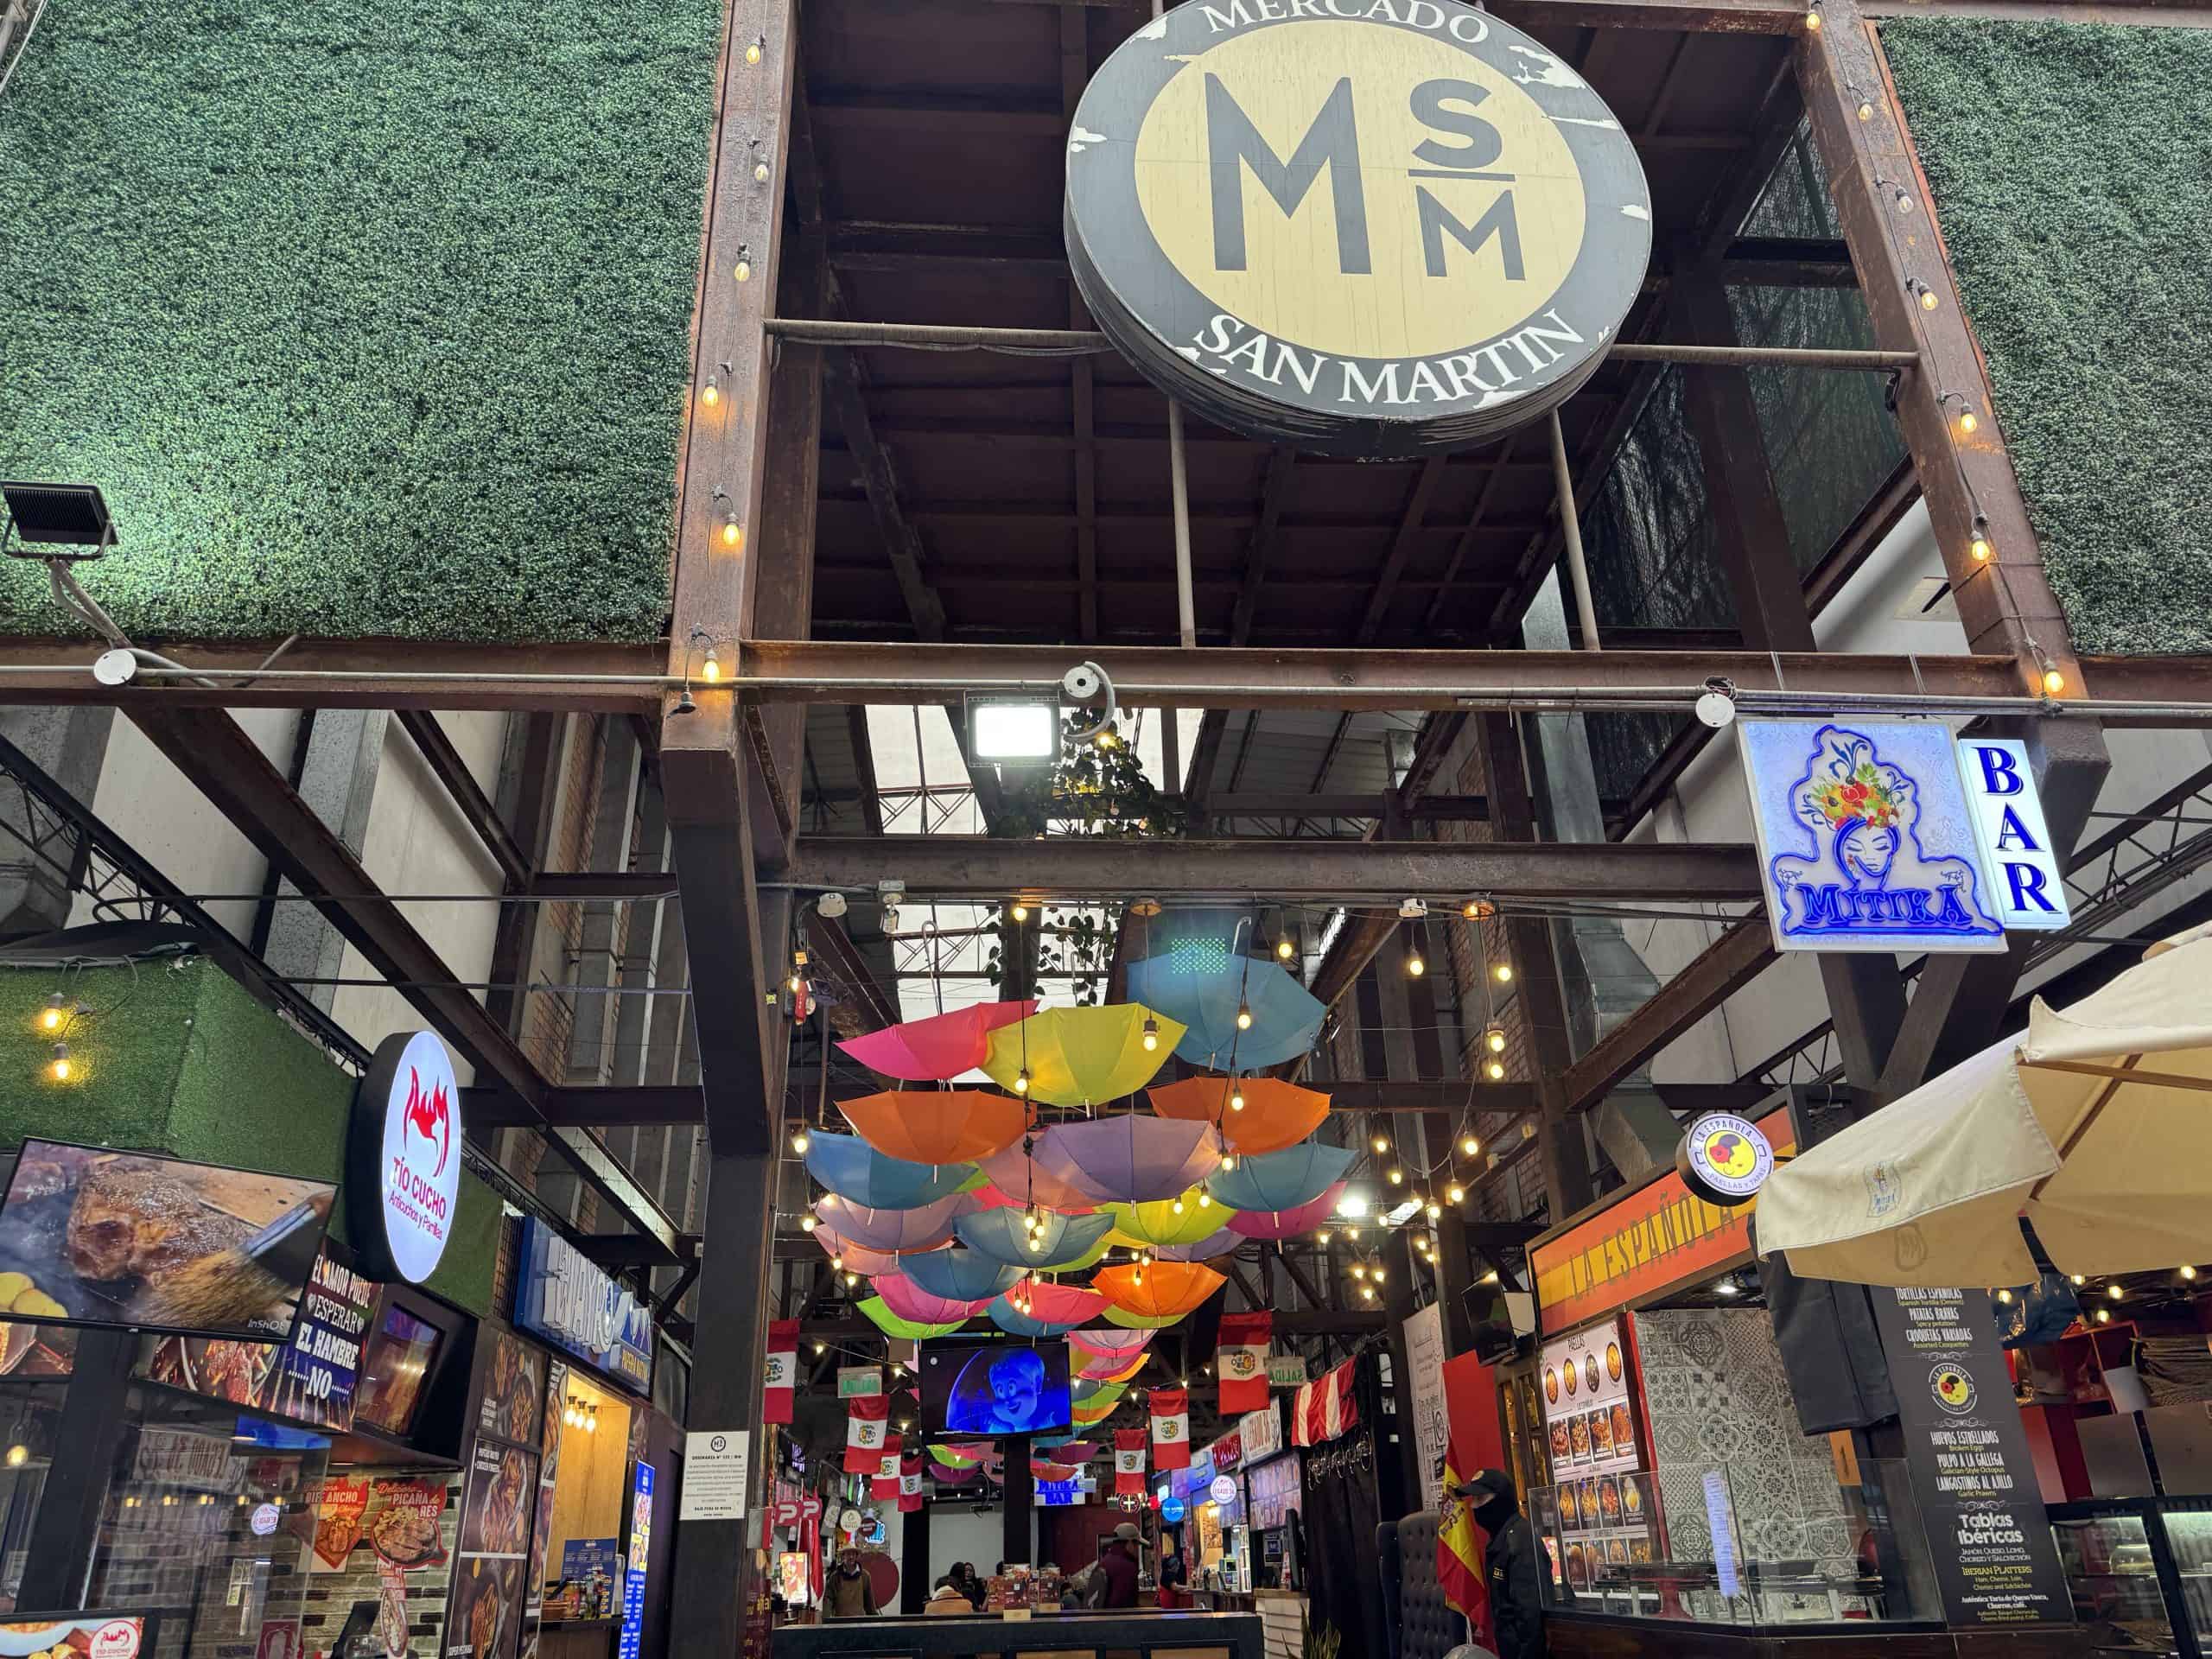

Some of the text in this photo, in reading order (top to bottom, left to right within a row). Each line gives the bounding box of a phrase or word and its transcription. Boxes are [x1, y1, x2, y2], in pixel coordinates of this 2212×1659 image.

[1196, 0, 1490, 43] MERCADO
[1205, 72, 1372, 276] M
[1193, 308, 1585, 407] SAN MARTIN
[1972, 746, 2062, 915] BAR
[1796, 882, 1974, 927] MITIKA
[1695, 1119, 1752, 1143] LA ESPAÑOLA
[388, 1189, 419, 1223] Anticuchos
[411, 1174, 447, 1221] CUCHO
[1569, 1192, 1737, 1300] LA ESPAÑOLA
[311, 1254, 372, 1309] EL AMOR PUEDE
[314, 1294, 358, 1335] ESPERAR
[1908, 1307, 1936, 1321] PATATAS
[295, 1321, 359, 1370] EL HAMBRE
[1905, 1327, 1974, 1343] CROQUETAS VARIADAS
[307, 1365, 333, 1400] NO
[1930, 1430, 1999, 1446] HUEVOS ESTRELLADOS
[1936, 1452, 2005, 1468] PULPO A LA GALLEGA
[325, 1491, 359, 1503] ANCHO
[1936, 1475, 1981, 1491] LANGOSTINOS
[1981, 1475, 1992, 1489] AL
[392, 1491, 429, 1505] PICAÑA
[1046, 1492, 1073, 1504] BAR
[1958, 1511, 2014, 1529] Tablas
[1957, 1527, 2024, 1545] Ibéricas
[1962, 1566, 2032, 1575] IBERIAN PLATTERS
